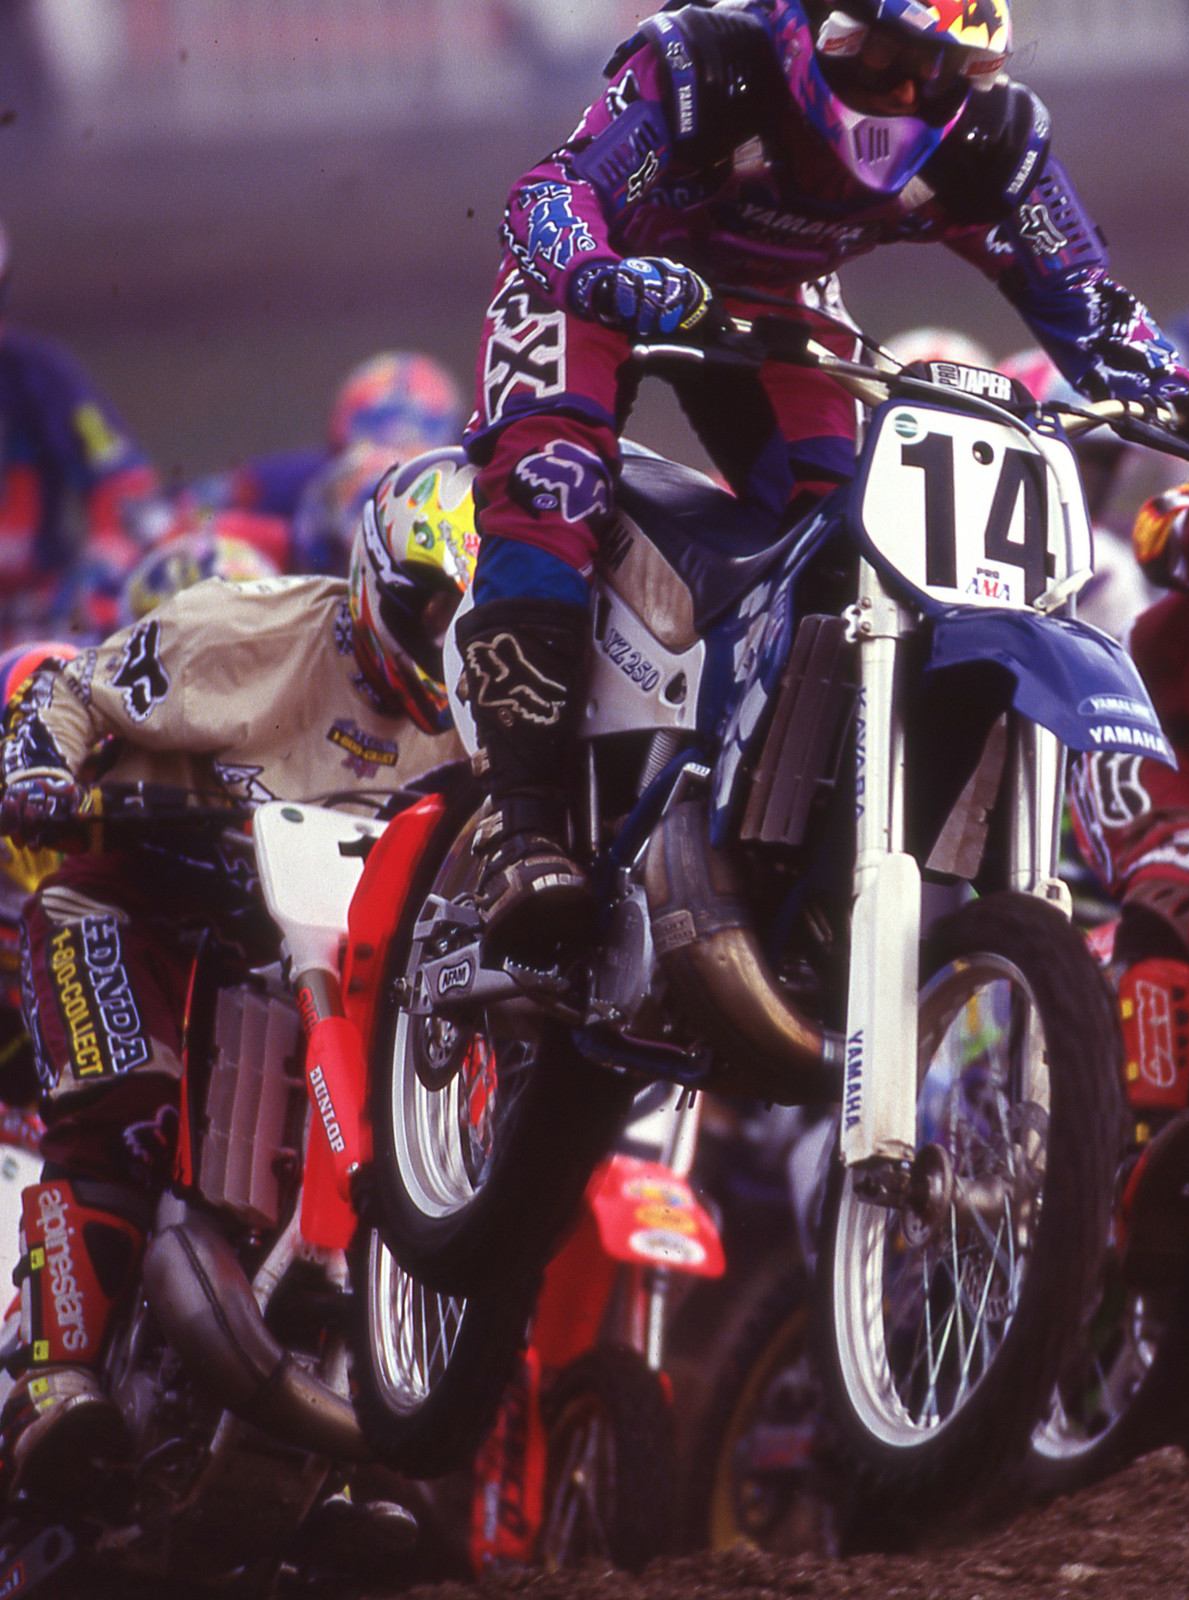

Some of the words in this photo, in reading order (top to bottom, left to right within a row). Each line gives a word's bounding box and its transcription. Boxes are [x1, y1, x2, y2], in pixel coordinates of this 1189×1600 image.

[937, 364, 958, 387] PRO
[958, 366, 1012, 402] TAPER
[901, 431, 1055, 605] 14
[965, 577, 1010, 602] AMA
[1089, 725, 1169, 758] YAMAHA
[309, 1064, 345, 1153] DUNLOP
[845, 1029, 864, 1132] YAMAHA
[37, 1188, 88, 1351] alpinestars
